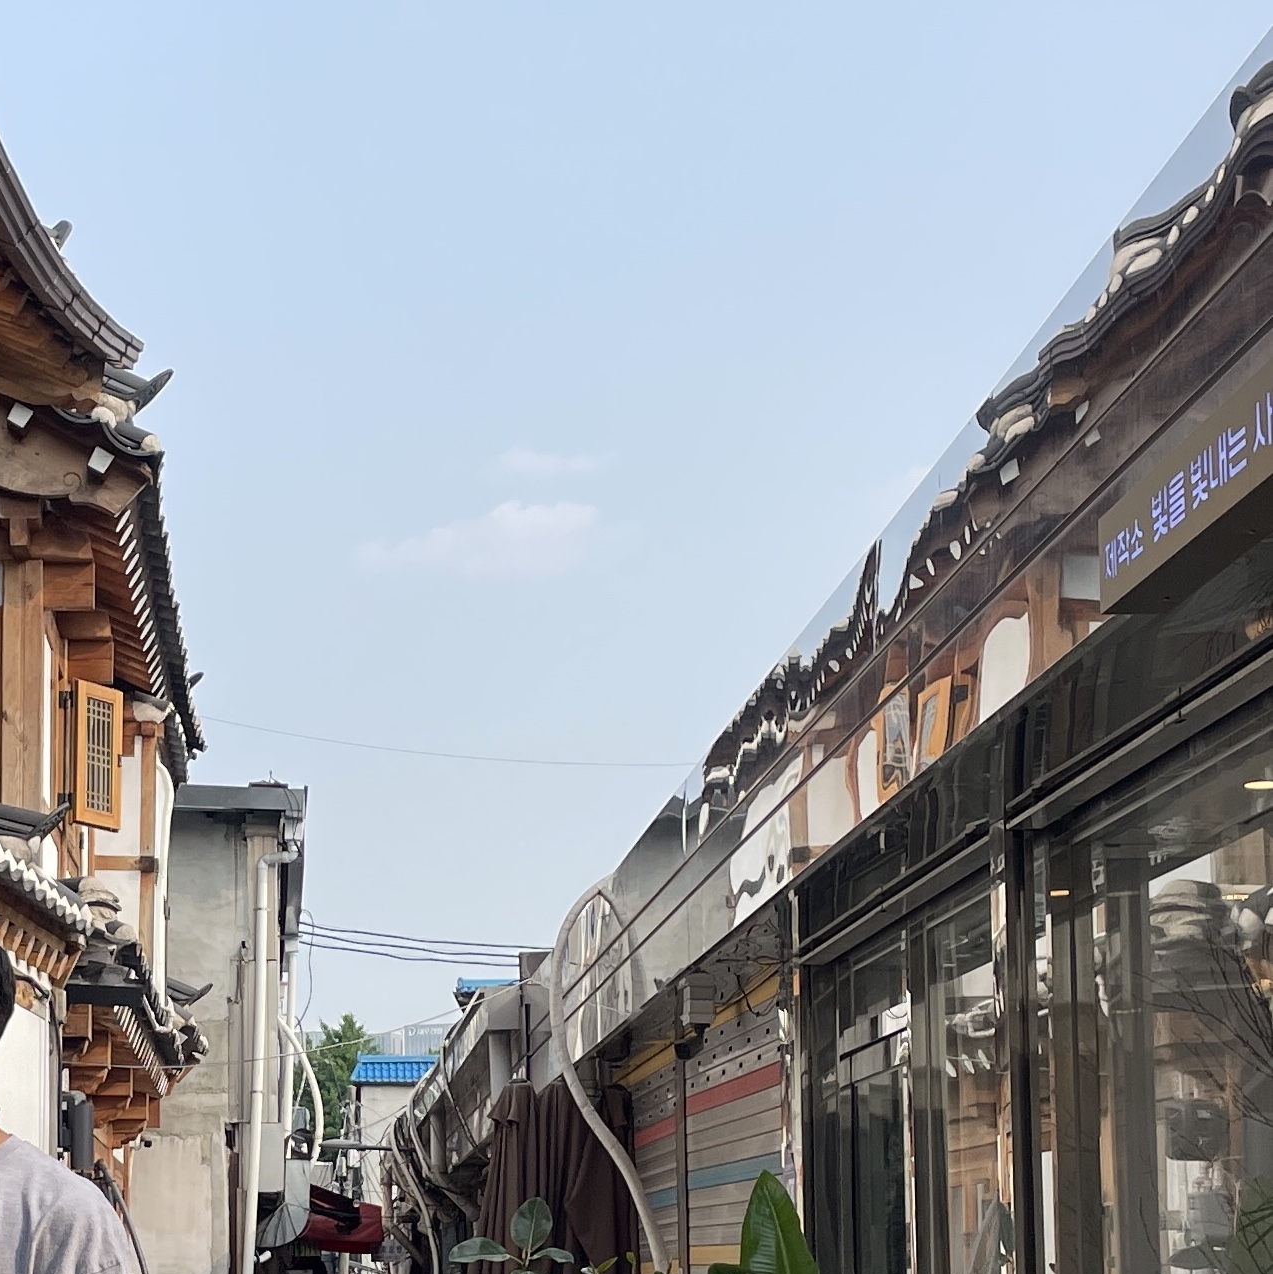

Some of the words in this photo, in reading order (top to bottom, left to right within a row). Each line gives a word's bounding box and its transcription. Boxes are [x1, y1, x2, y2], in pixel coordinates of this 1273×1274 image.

[1105, 519, 1144, 579] 제작소
[1151, 470, 1186, 543] 빛을
[1190, 425, 1247, 509] 빛내는
